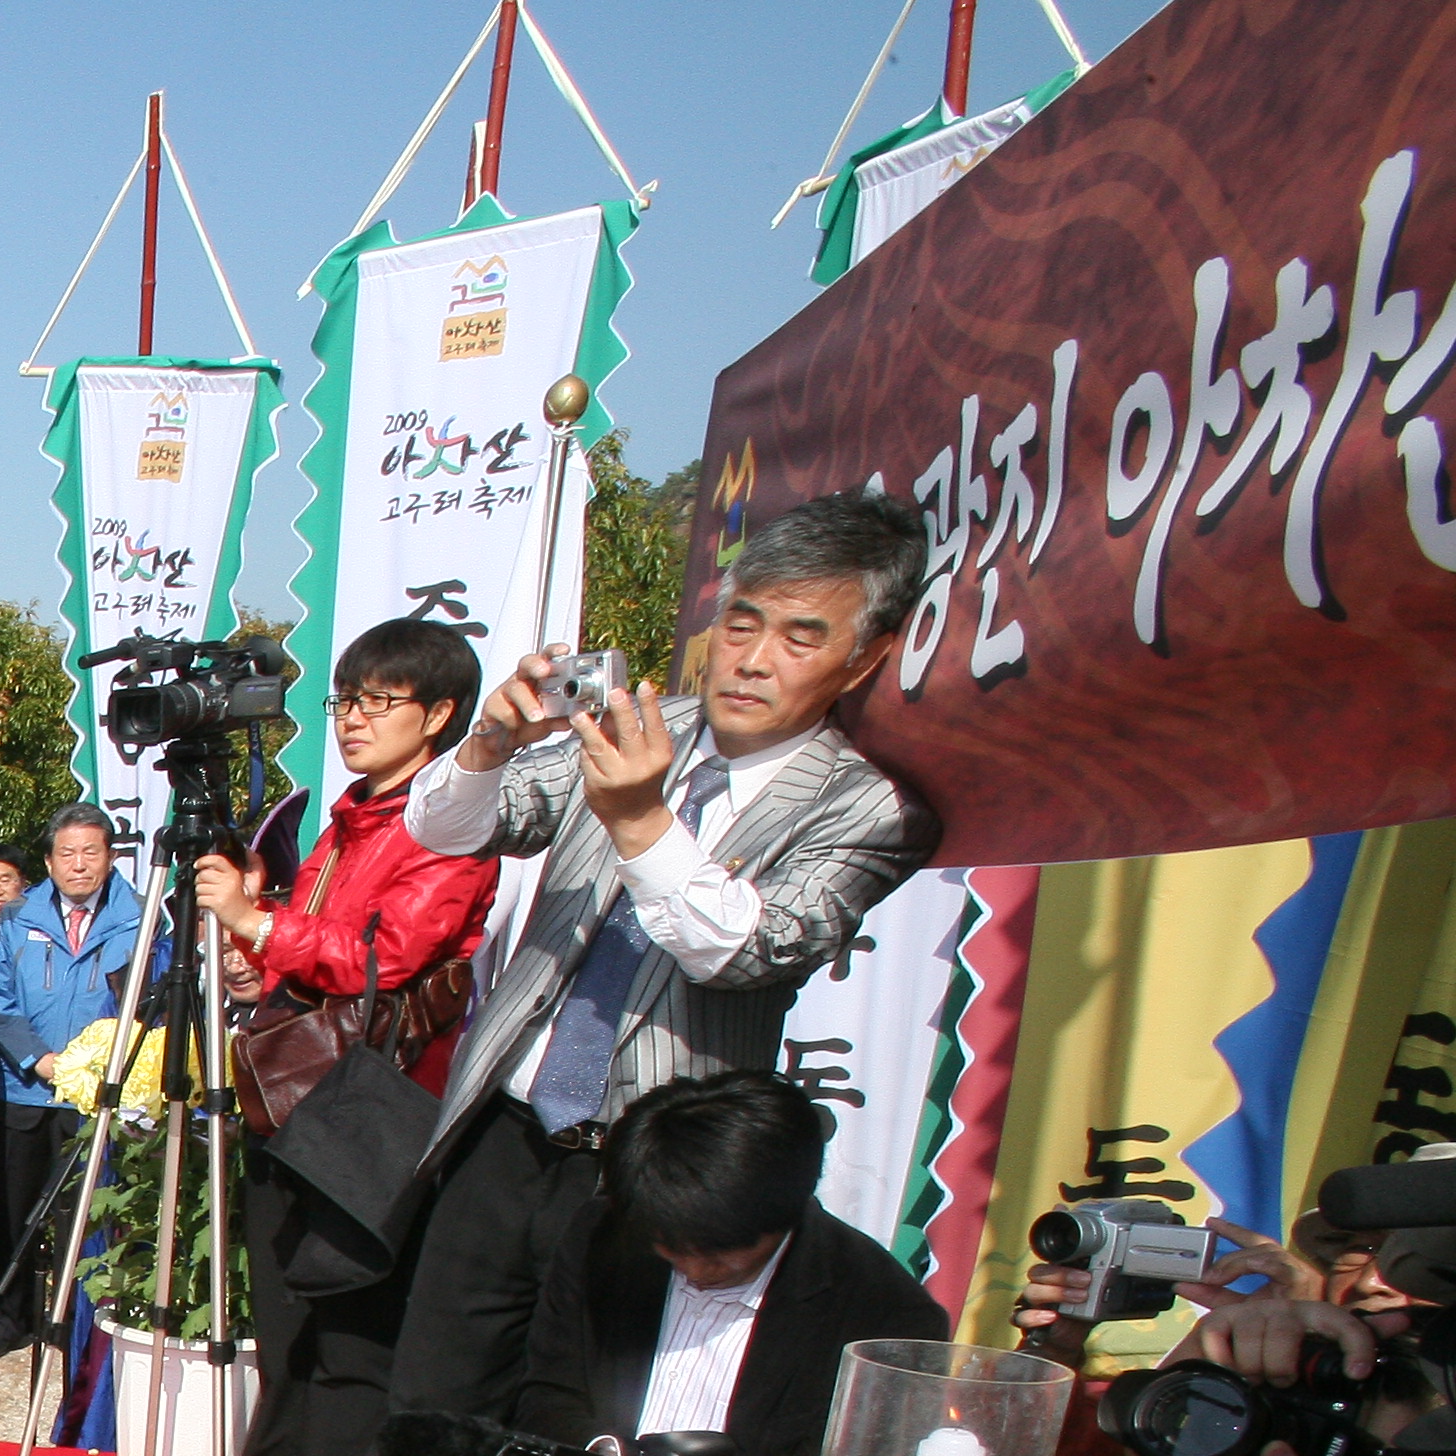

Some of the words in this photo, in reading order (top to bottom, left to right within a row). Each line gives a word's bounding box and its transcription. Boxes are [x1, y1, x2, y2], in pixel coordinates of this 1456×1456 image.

[445, 318, 502, 338] 아차산
[383, 409, 429, 435] 2009
[380, 415, 534, 481] 아차산
[379, 489, 464, 524] 고구려
[468, 478, 533, 520] 축제
[899, 339, 1077, 691] 광진
[92, 518, 127, 537] 2009
[93, 528, 197, 588] 아차산
[93, 592, 154, 620] 고구려
[156, 589, 197, 626] 축제
